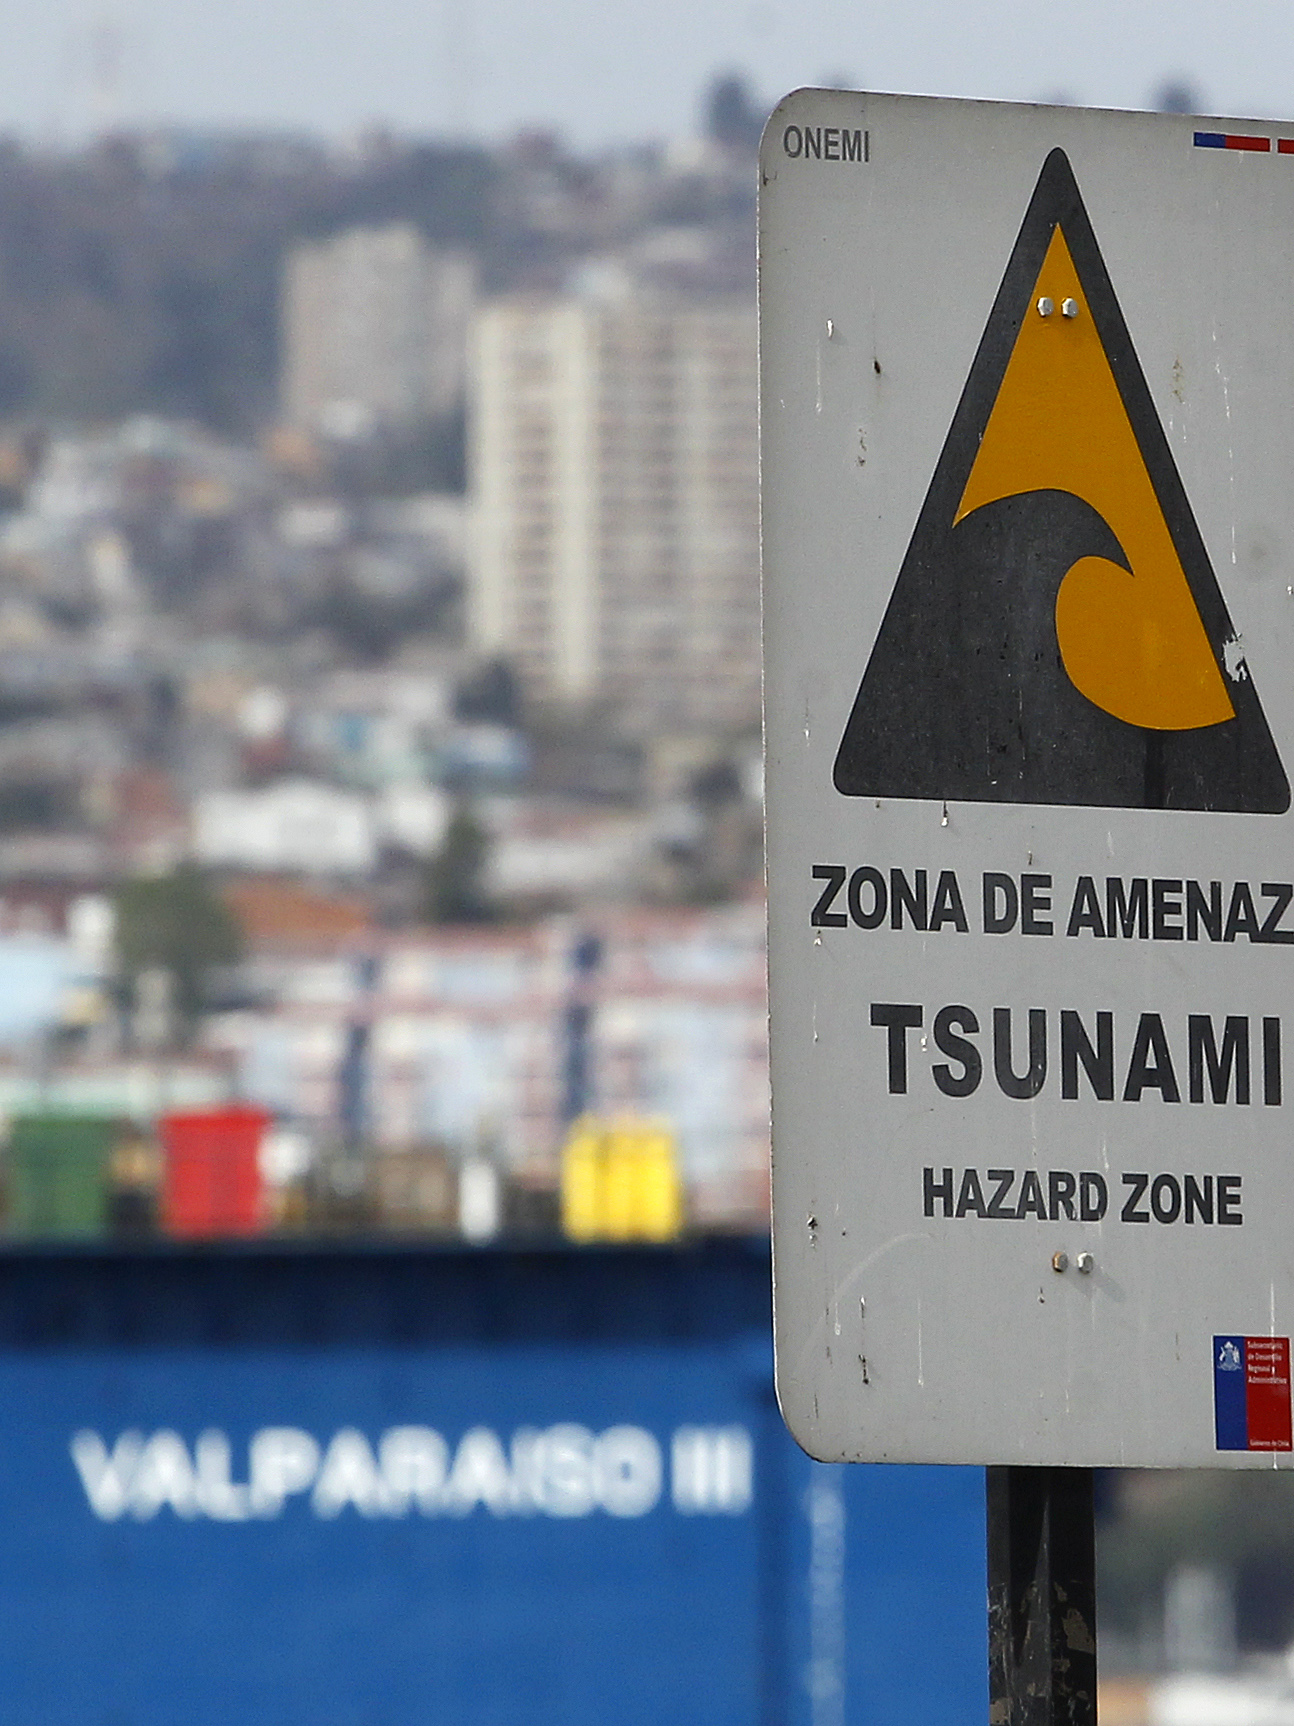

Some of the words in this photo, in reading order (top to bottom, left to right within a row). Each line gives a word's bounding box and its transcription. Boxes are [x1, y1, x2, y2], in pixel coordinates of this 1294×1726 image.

[783, 125, 870, 162] ONEMI
[811, 865, 968, 934] ZONA
[982, 872, 1053, 936] DE
[870, 1003, 1282, 1106] TSUNAMI
[922, 1167, 1108, 1222] HAZARD
[1121, 1173, 1243, 1225] ZONE
[69, 1423, 663, 1521] VALPARAISO
